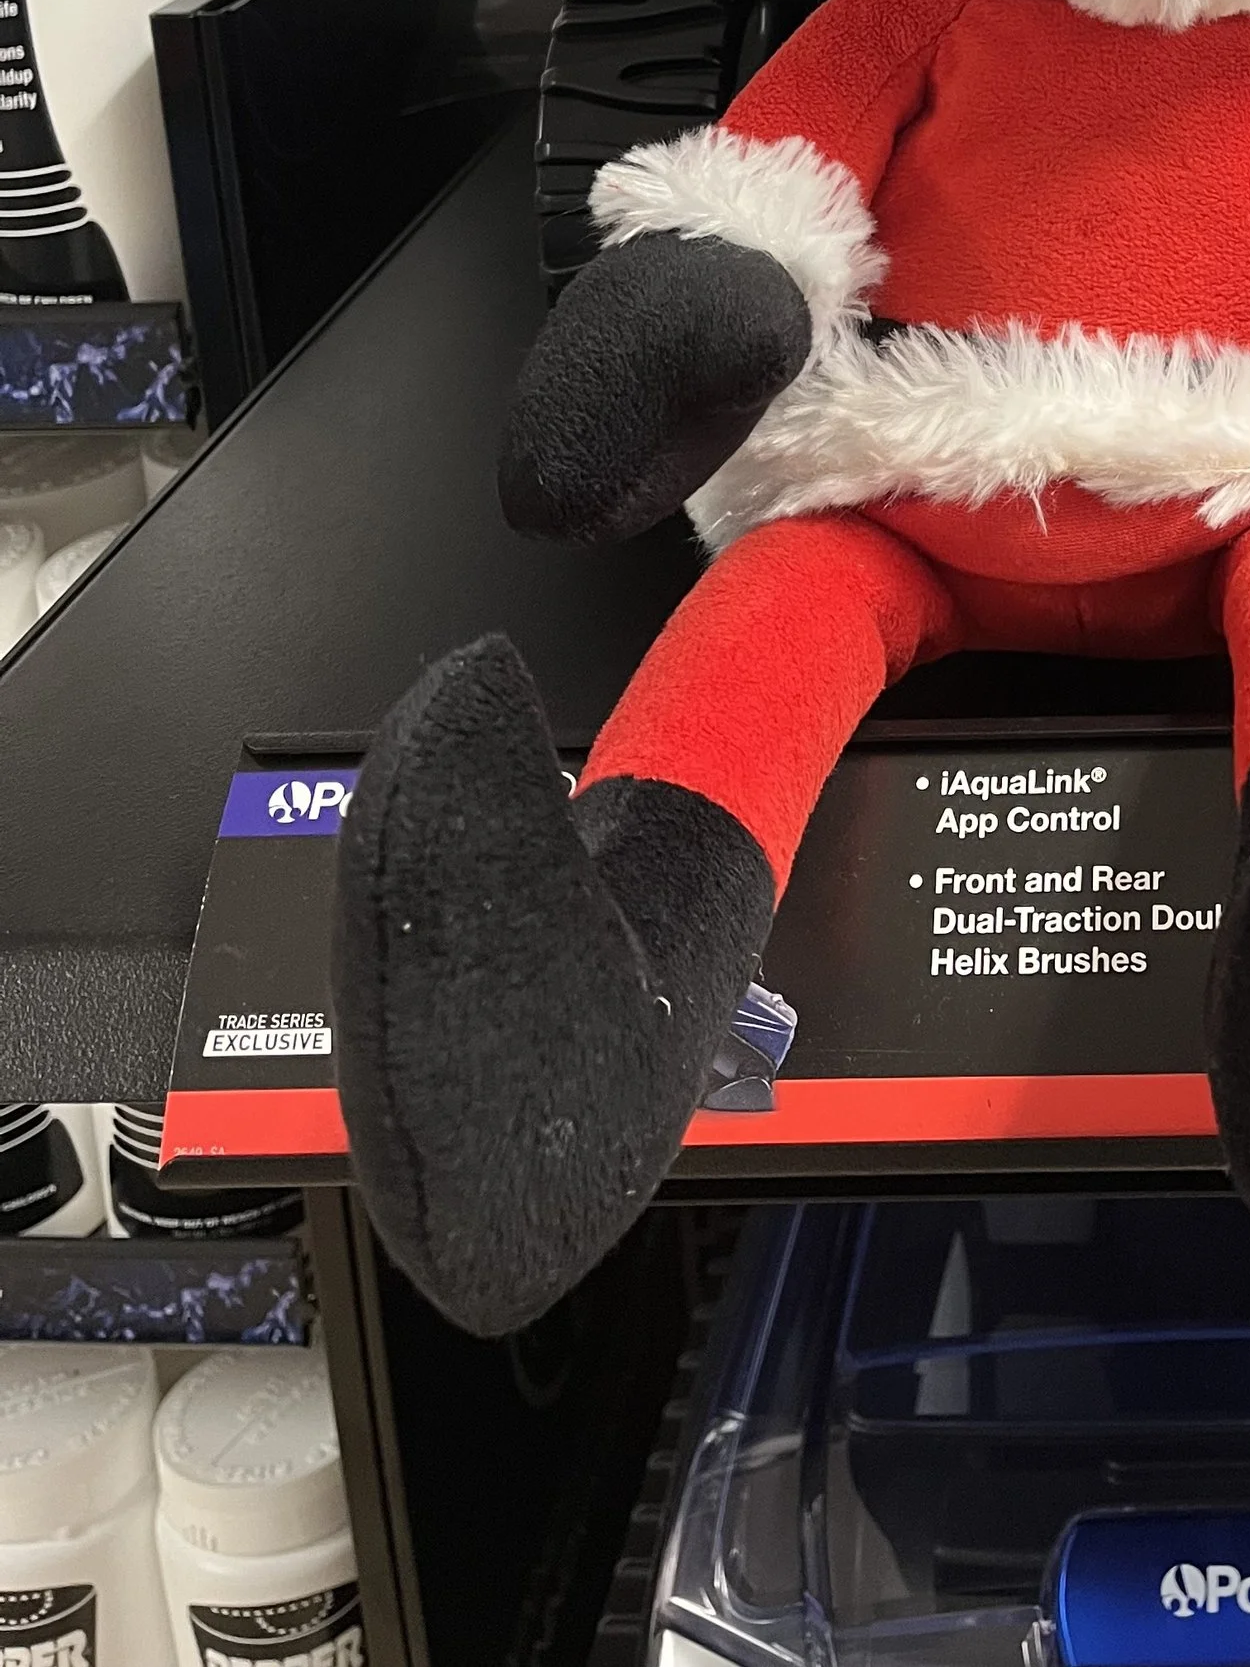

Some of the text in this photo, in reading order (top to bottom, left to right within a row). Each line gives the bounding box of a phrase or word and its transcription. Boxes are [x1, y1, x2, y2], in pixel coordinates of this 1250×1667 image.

[0, 91, 37, 110] larity
[936, 805, 1122, 835] App Control
[934, 864, 1165, 895] Front and Rear
[932, 904, 1142, 936] Dual-Traction
[930, 945, 1148, 977] Helix Brushes
[218, 1012, 325, 1030] TRADE SERIES
[212, 1032, 325, 1052] EXCLUSIVE
